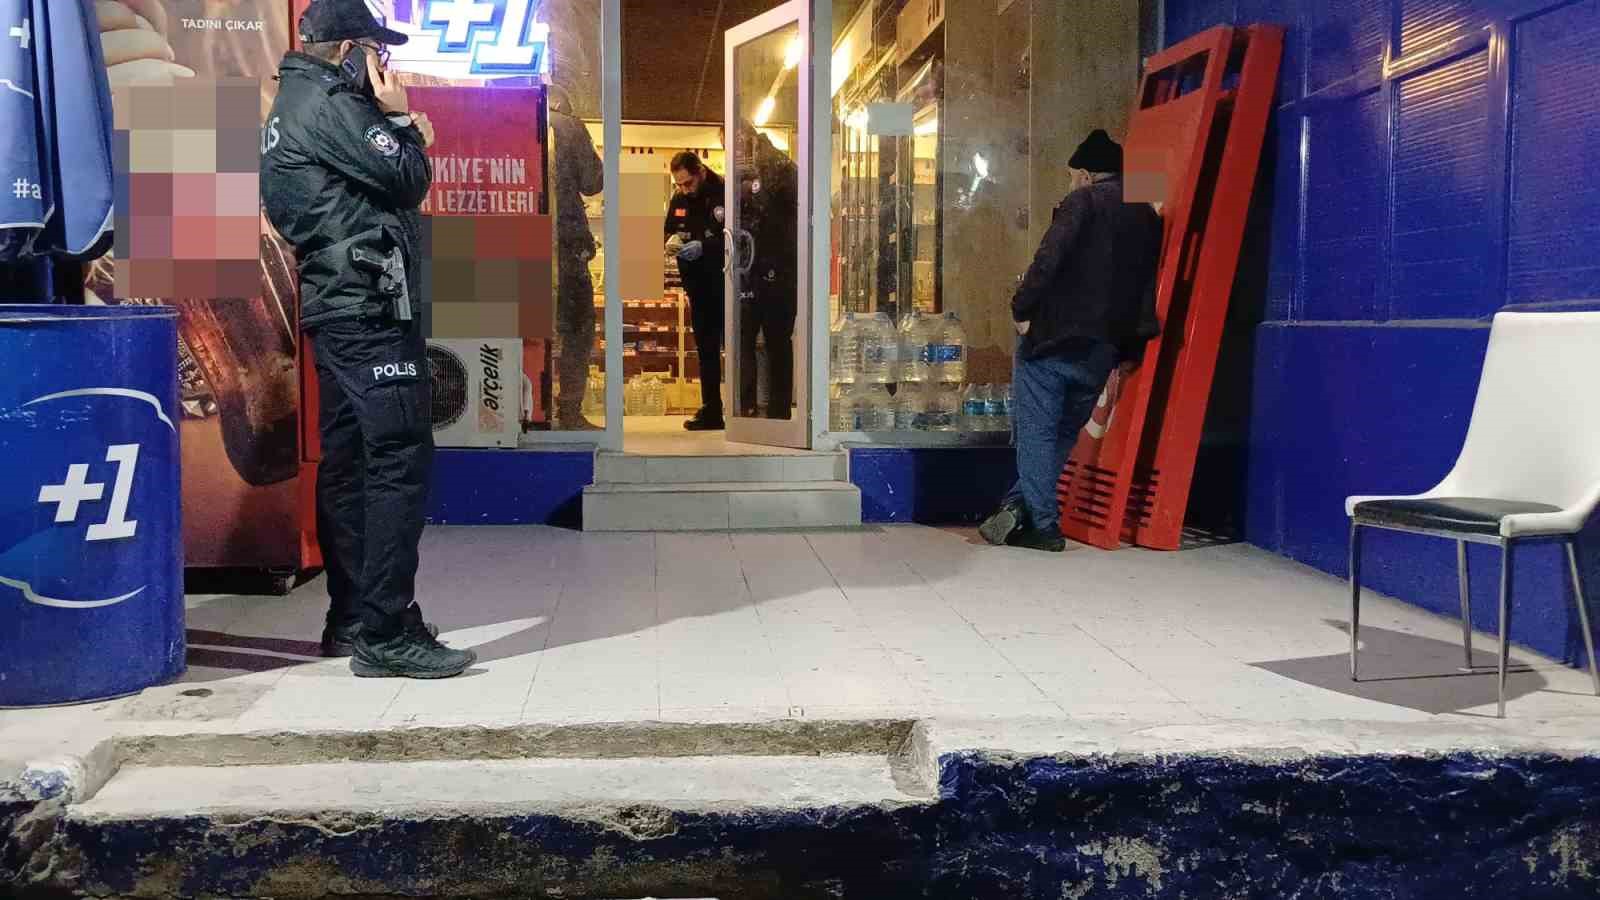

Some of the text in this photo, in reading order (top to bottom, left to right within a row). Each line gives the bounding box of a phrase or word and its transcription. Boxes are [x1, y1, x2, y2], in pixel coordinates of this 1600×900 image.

[181, 18, 265, 32] TADINI ÇIKAR
[438, 186, 535, 213] LEZZETLERİ
[479, 344, 503, 410] arçelik
[38, 443, 140, 541] +1
